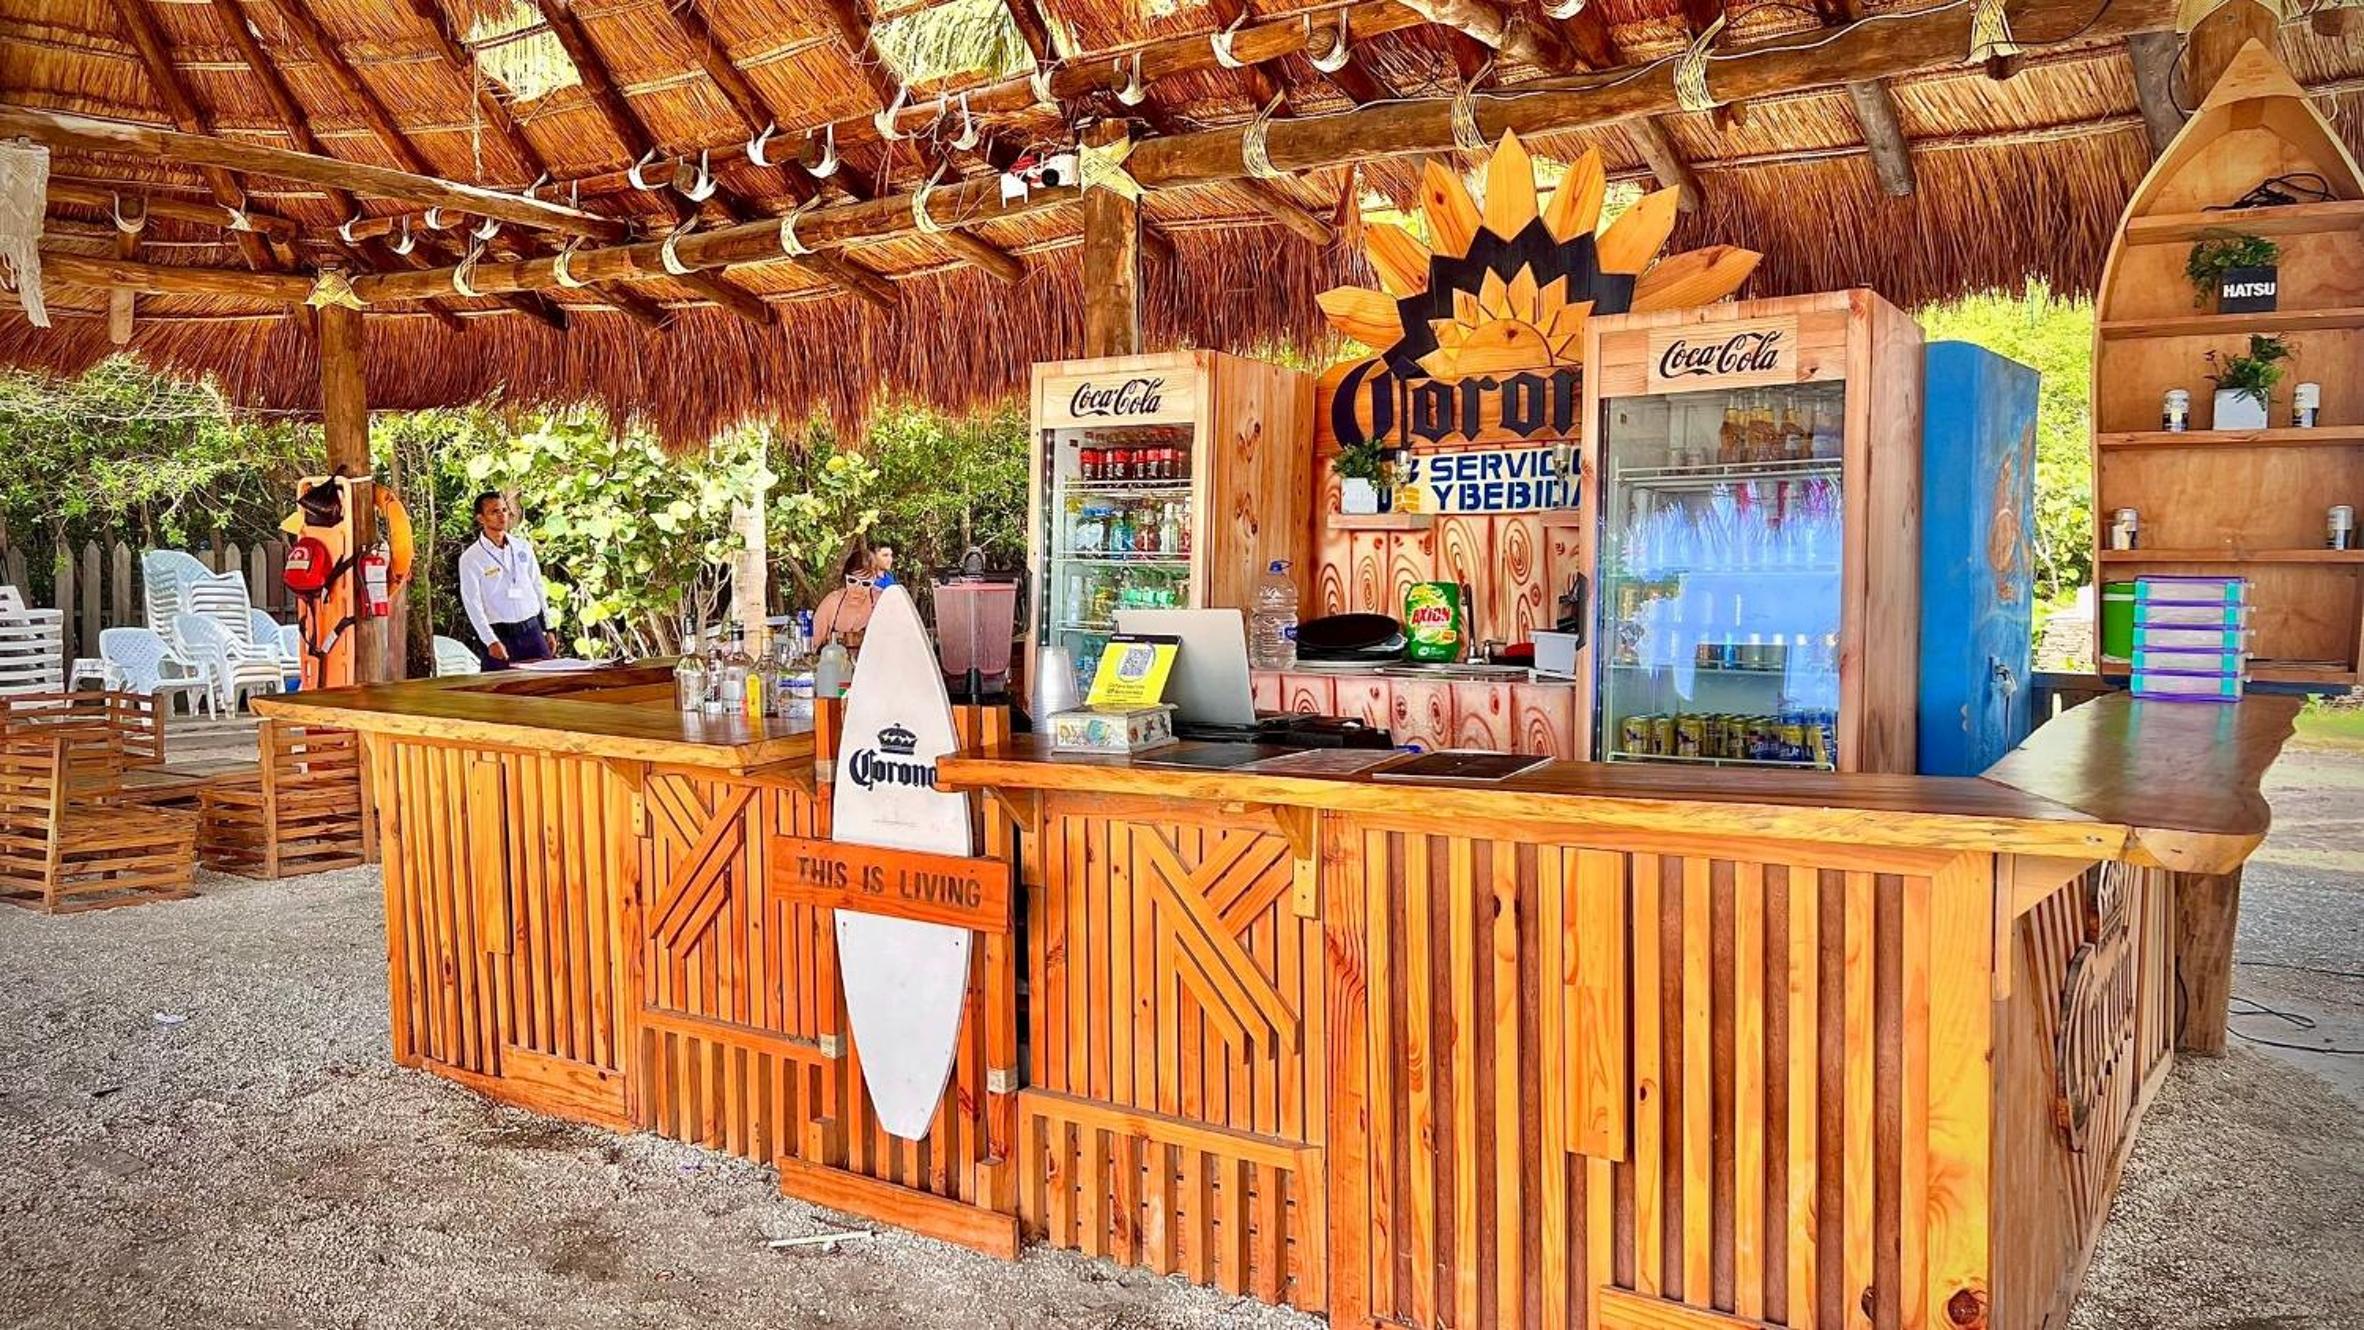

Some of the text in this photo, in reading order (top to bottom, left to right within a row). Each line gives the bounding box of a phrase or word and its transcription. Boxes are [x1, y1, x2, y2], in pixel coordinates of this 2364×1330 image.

[2223, 282, 2276, 298] HATSU
[1659, 331, 1783, 378] Coca-Cola
[1069, 378, 1165, 418] Coca-Cola
[1430, 449, 1581, 483] SERVIC
[797, 856, 982, 909] THIS IS LIVING
